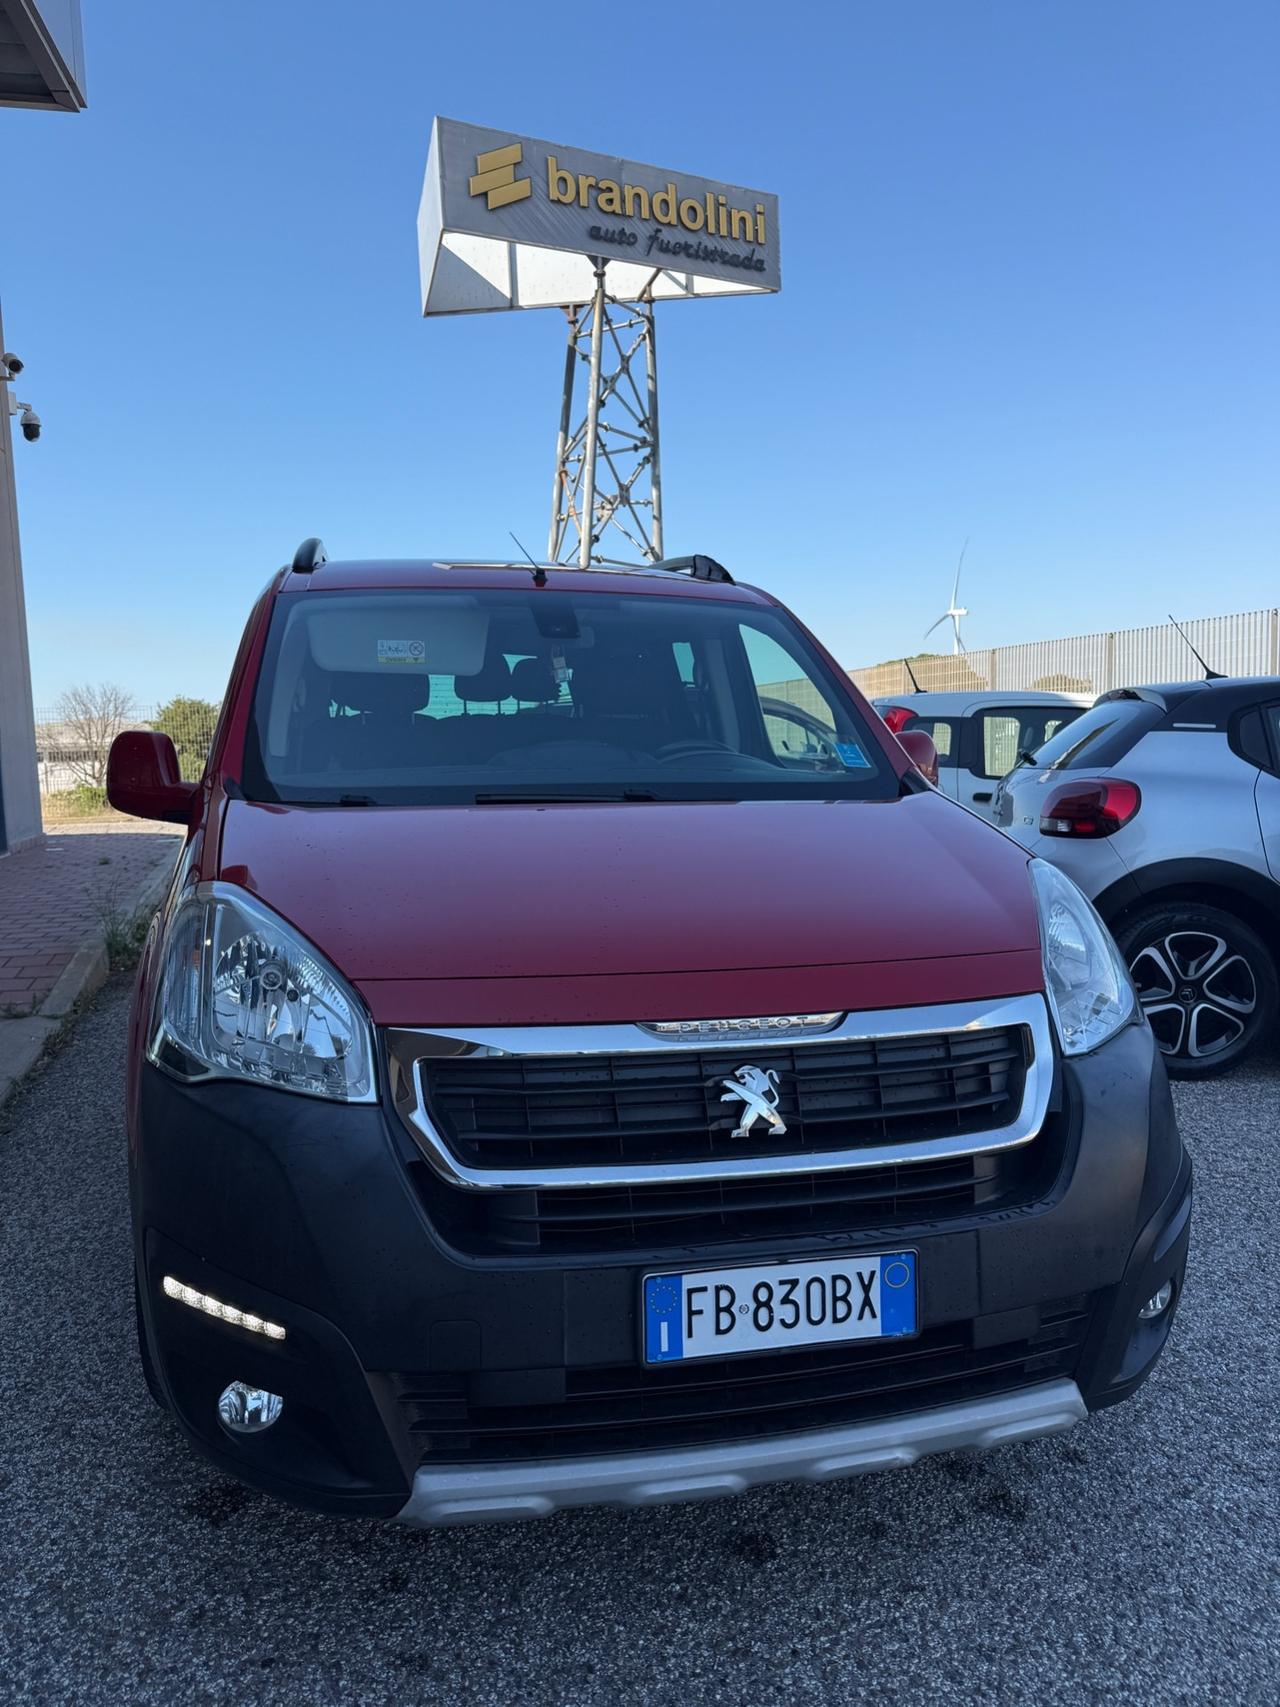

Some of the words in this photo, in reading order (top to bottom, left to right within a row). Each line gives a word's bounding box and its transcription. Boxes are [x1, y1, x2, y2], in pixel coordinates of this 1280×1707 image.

[547, 155, 766, 245] brandolini
[589, 225, 638, 247] auto
[646, 227, 767, 272] fuoristrada
[679, 1016, 808, 1034] PEUGEOT
